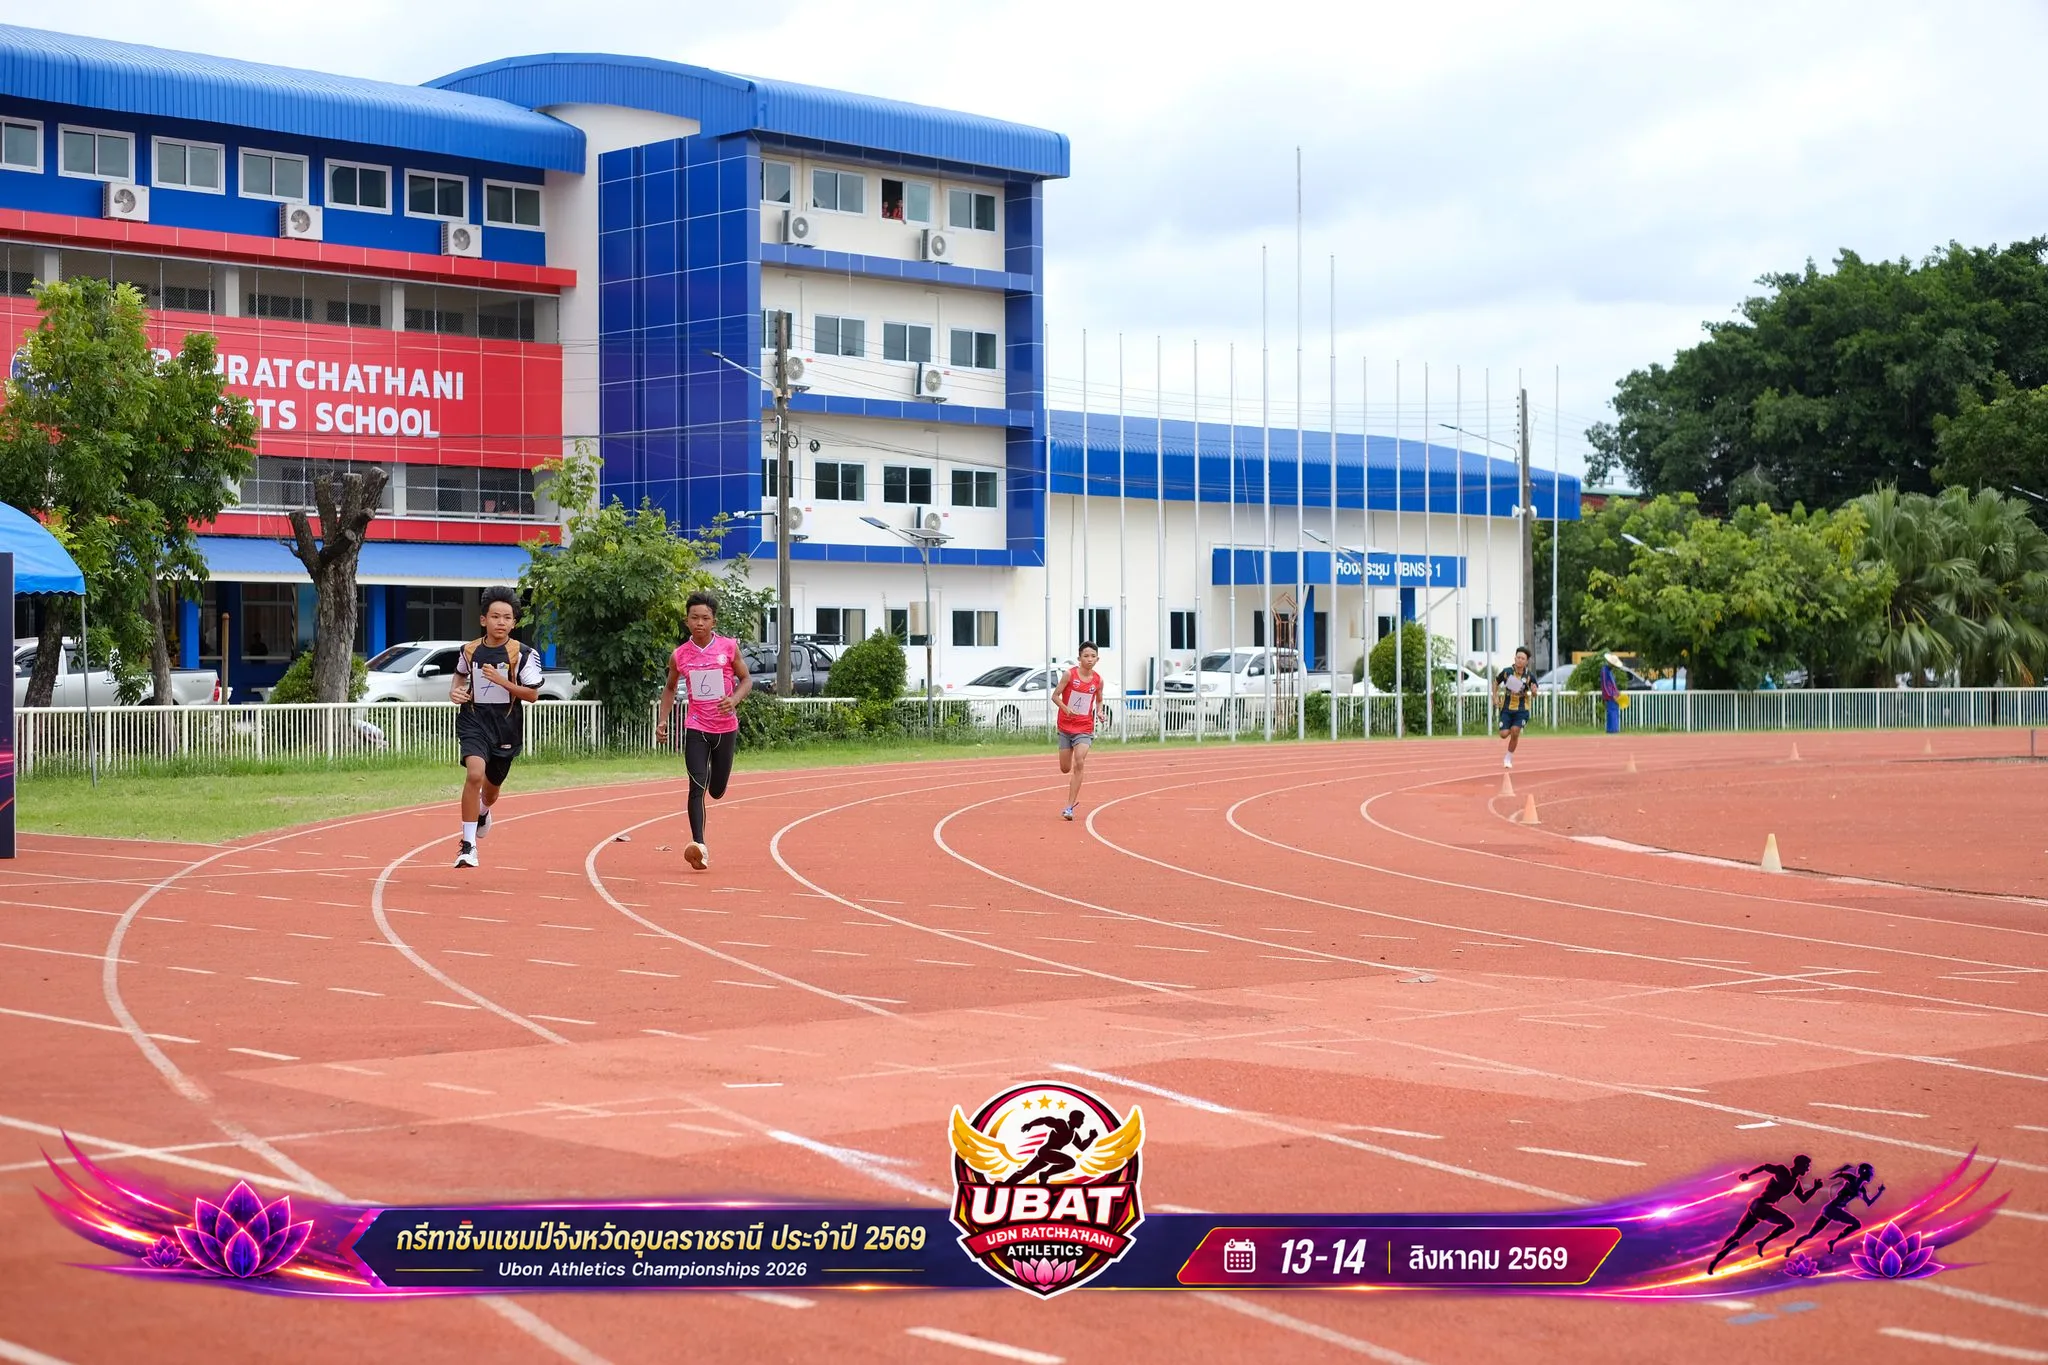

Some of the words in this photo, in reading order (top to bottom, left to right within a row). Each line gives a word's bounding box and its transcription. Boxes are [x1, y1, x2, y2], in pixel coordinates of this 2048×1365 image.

[315, 402, 441, 438] SCHOOL
[1435, 563, 1441, 578] 1
[700, 672, 712, 695] 6
[1073, 696, 1082, 710] 4
